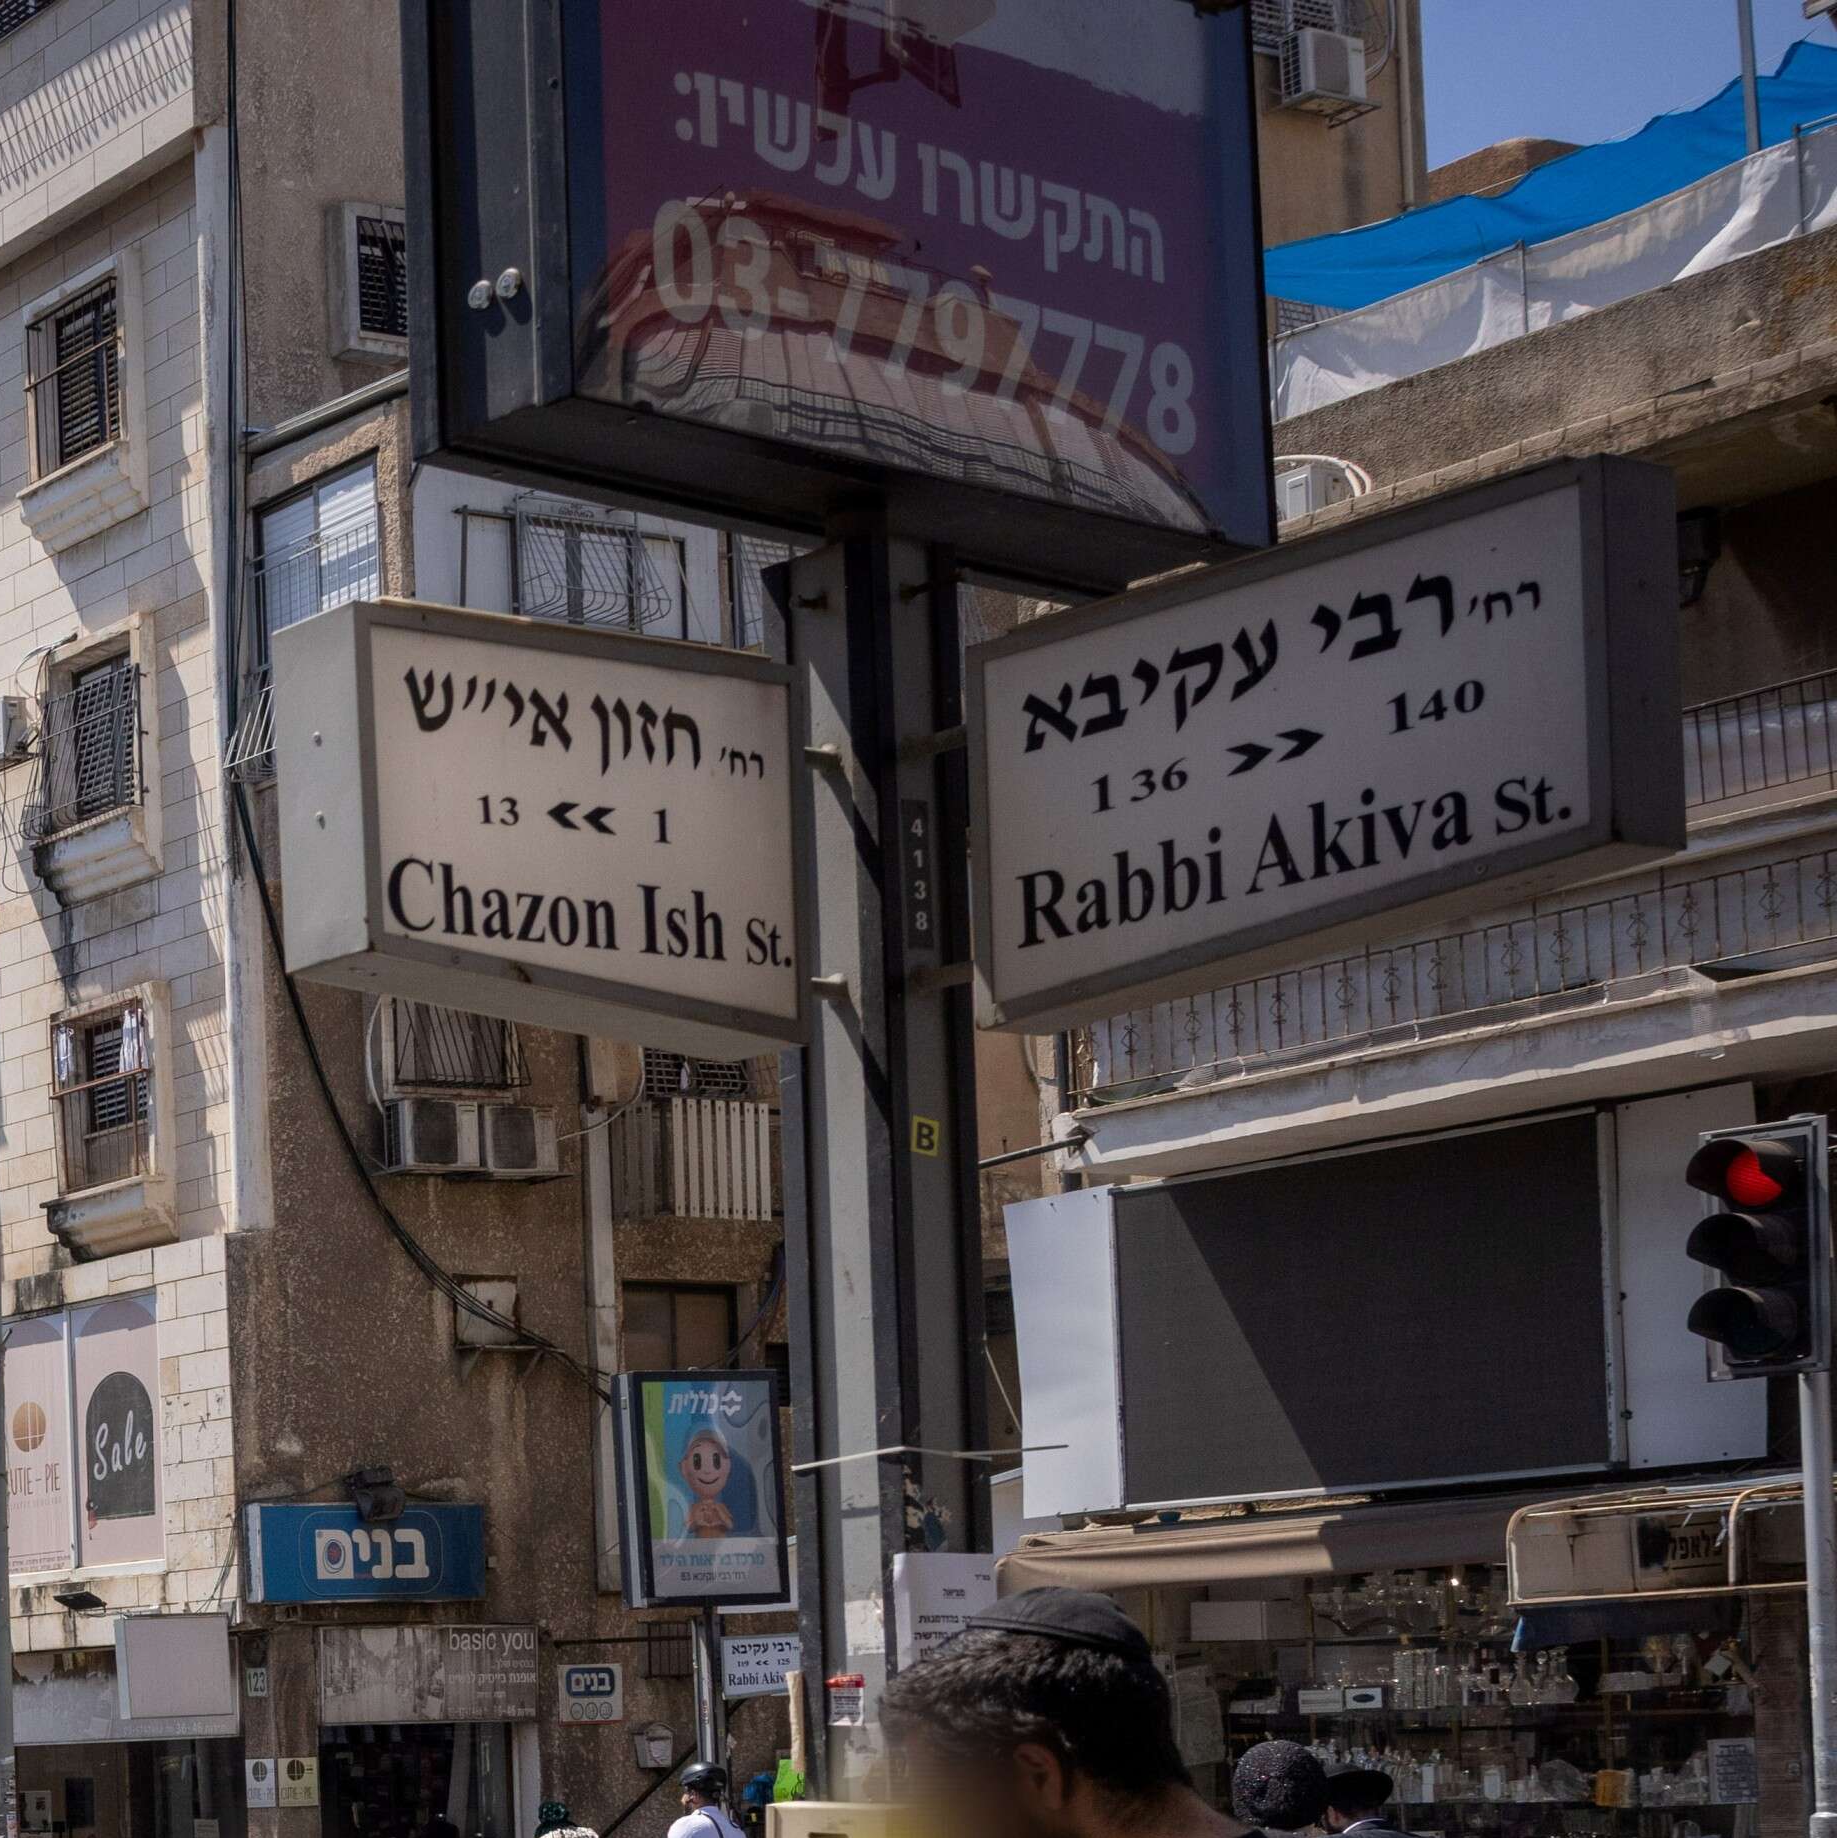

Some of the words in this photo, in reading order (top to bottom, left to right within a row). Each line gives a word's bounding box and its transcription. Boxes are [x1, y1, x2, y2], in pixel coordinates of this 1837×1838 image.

[673, 72, 900, 195] עכשיו:
[922, 142, 1165, 282] התקשרו
[653, 193, 1198, 458] 03-7797778
[1315, 573, 1453, 665] רבי
[1022, 616, 1281, 756] עקיבא
[1385, 677, 1486, 734] 140
[597, 693, 702, 780] חזון
[475, 795, 521, 829] 13
[651, 806, 672, 845] 1
[1016, 825, 1226, 950] Rabbi
[1256, 778, 1472, 889] Akiva
[1495, 770, 1573, 829] St.
[387, 857, 619, 953] Chazon
[642, 880, 726, 963] Ish
[743, 921, 794, 970] St.
[668, 1390, 721, 1416] כללית
[93, 1424, 147, 1481] Sale
[316, 1527, 431, 1580] בנים
[660, 1553, 686, 1566] הילד
[449, 1627, 496, 1652] basic
[501, 1632, 534, 1657] you
[731, 1642, 769, 1656] עקיבא
[772, 1641, 792, 1652] רבי
[247, 1671, 266, 1693] 123
[570, 1672, 612, 1692] בנים
[728, 1672, 759, 1686] Rabbi
[761, 1671, 787, 1685] Akiv
